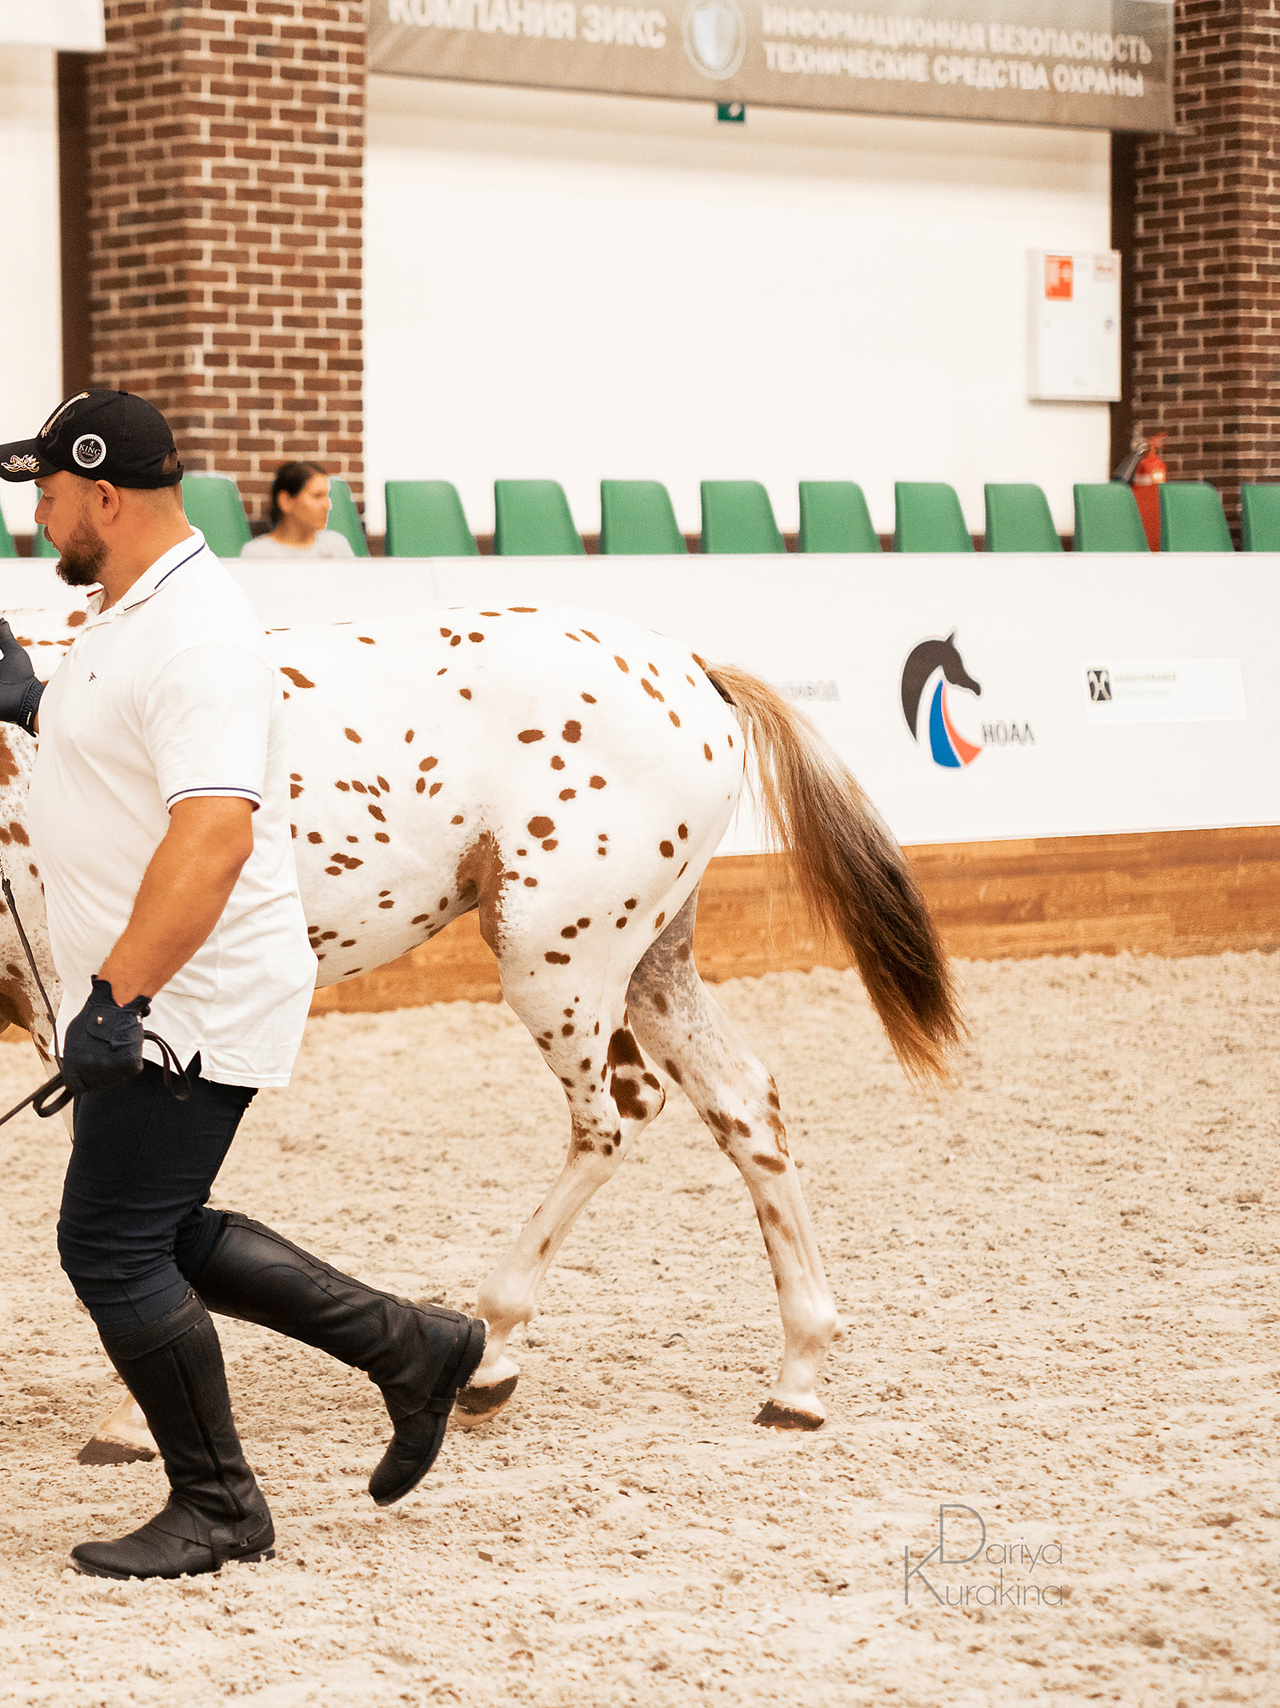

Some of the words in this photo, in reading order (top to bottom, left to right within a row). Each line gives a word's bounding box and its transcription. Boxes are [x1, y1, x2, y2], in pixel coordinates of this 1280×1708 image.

[389, 0, 577, 39] КОМПАНИЯ
[581, 3, 667, 48] ЗИКС
[762, 4, 985, 51] ИНФОРМАЦИОННАЯ
[988, 24, 1152, 64] БЕЗОПАСНОСТЬ
[763, 41, 927, 82] ТЕХНИЧЕСКИЕ
[932, 55, 1049, 90] СРЕДСТВА
[1052, 63, 1144, 97] ОХРАНЫ
